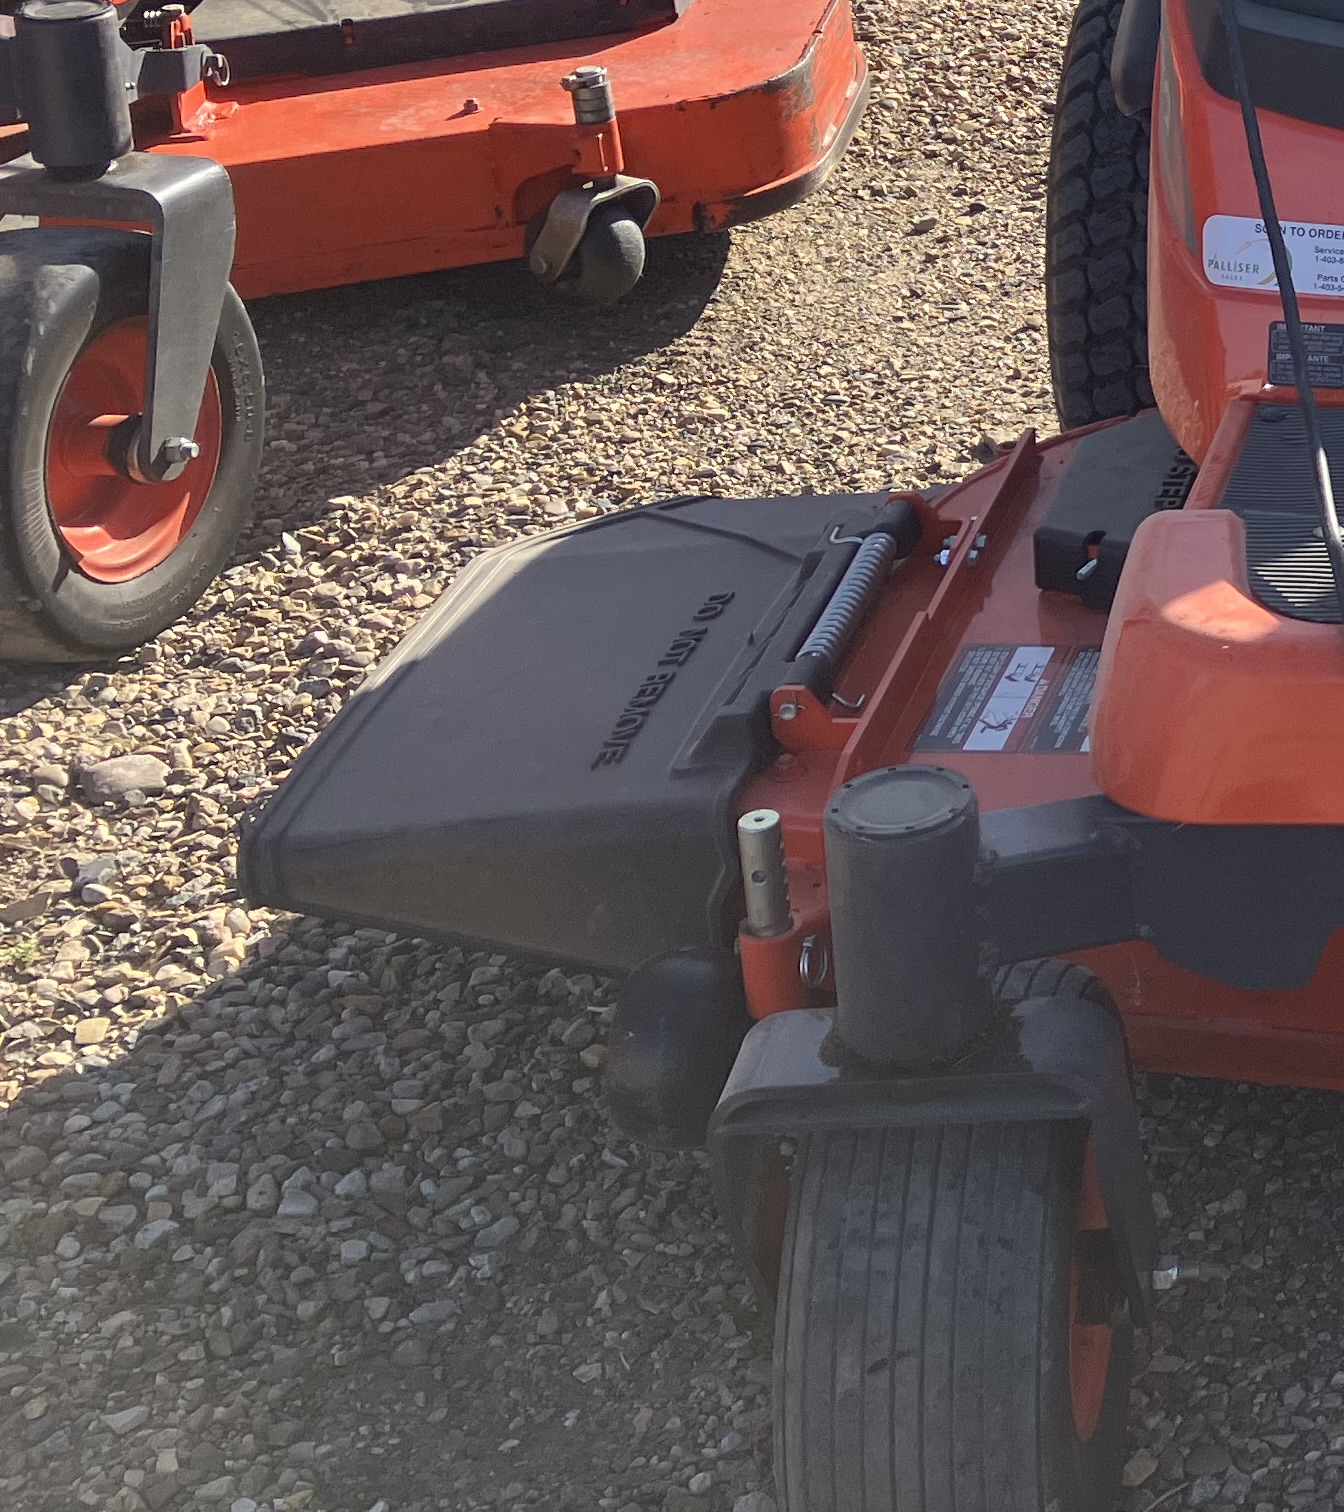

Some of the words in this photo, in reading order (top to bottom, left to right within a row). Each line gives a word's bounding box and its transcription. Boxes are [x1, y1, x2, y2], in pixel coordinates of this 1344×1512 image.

[1290, 226, 1306, 237] TO
[1314, 245, 1344, 255] Service
[1207, 258, 1260, 275] PALLISER
[1317, 273, 1338, 283] Parts
[691, 591, 736, 623] DO
[657, 627, 709, 667] NOT
[1020, 684, 1049, 719] DANGER
[590, 671, 678, 773] REMOVE
